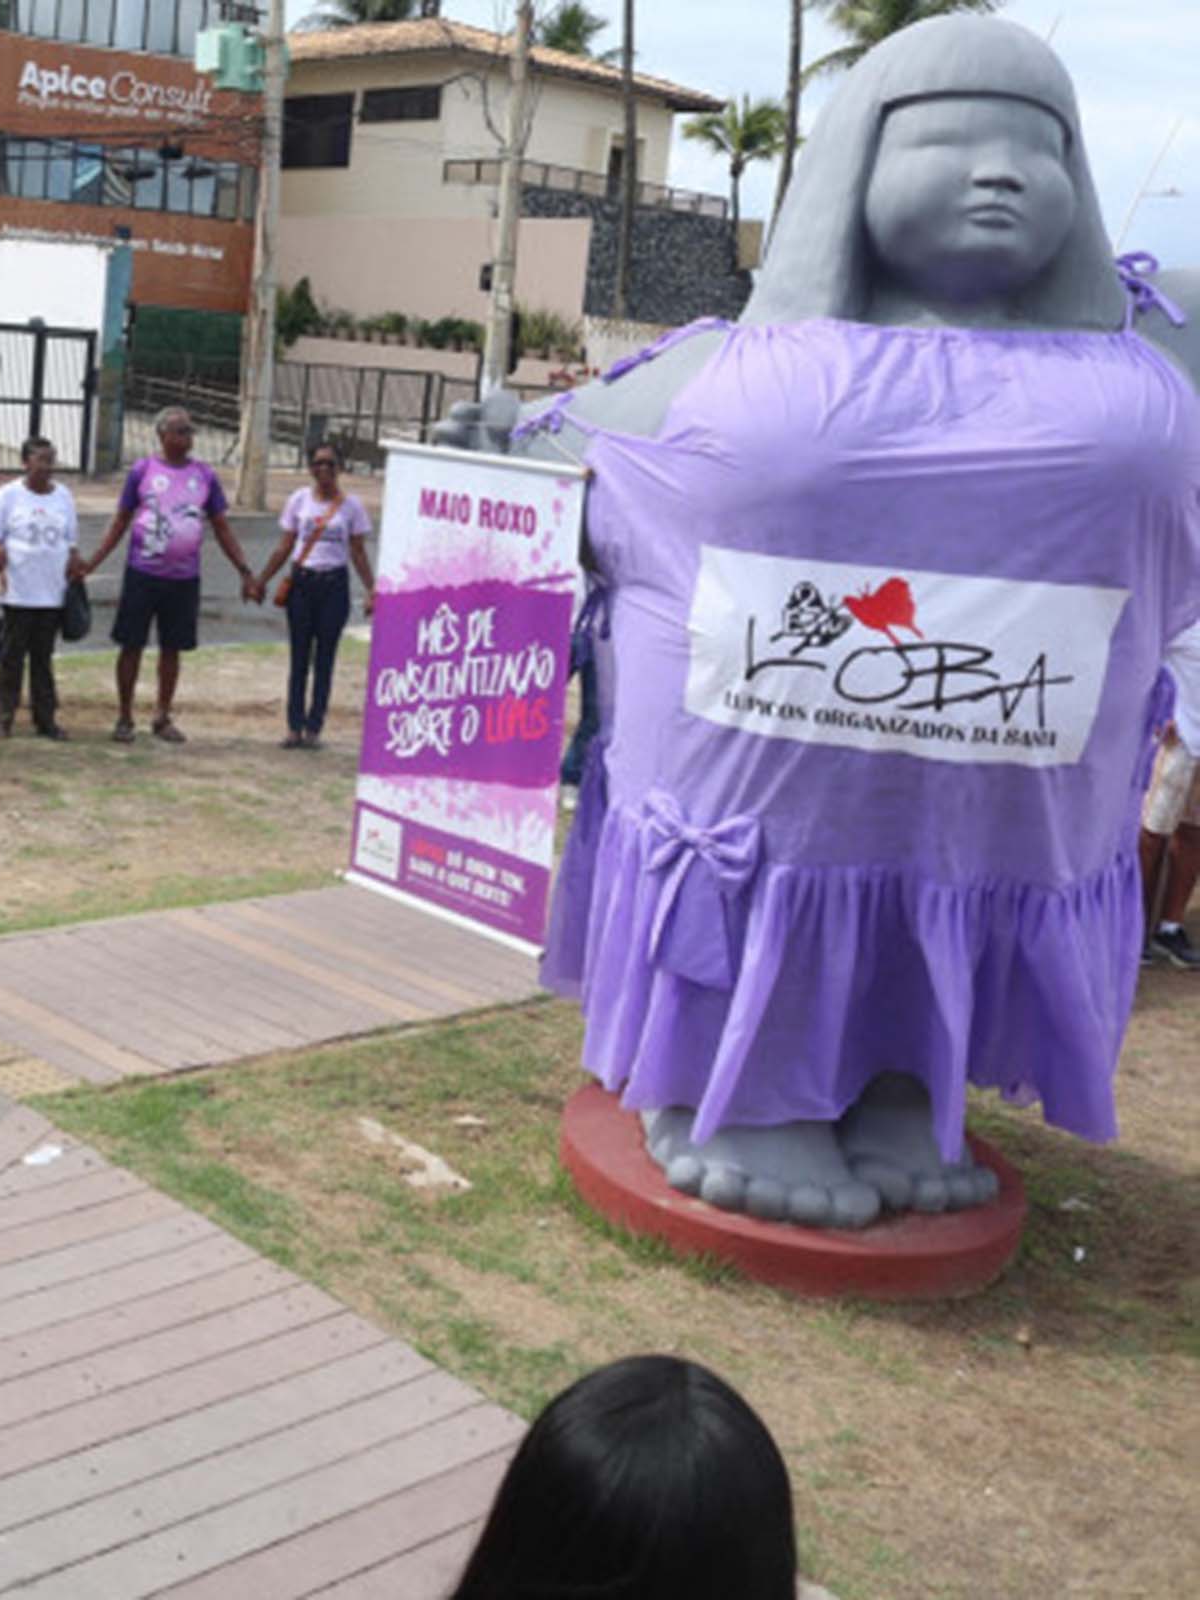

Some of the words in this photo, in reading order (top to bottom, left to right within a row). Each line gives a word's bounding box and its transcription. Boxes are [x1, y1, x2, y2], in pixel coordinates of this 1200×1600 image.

[418, 488, 471, 524] MAIO
[478, 498, 537, 538] ROXO
[417, 602, 461, 656] MÊS
[463, 606, 497, 653] DE
[746, 616, 1073, 729] LOBA
[385, 702, 456, 758] SOBRE
[460, 704, 481, 745] O
[814, 707, 966, 742] ORGANIZADOS
